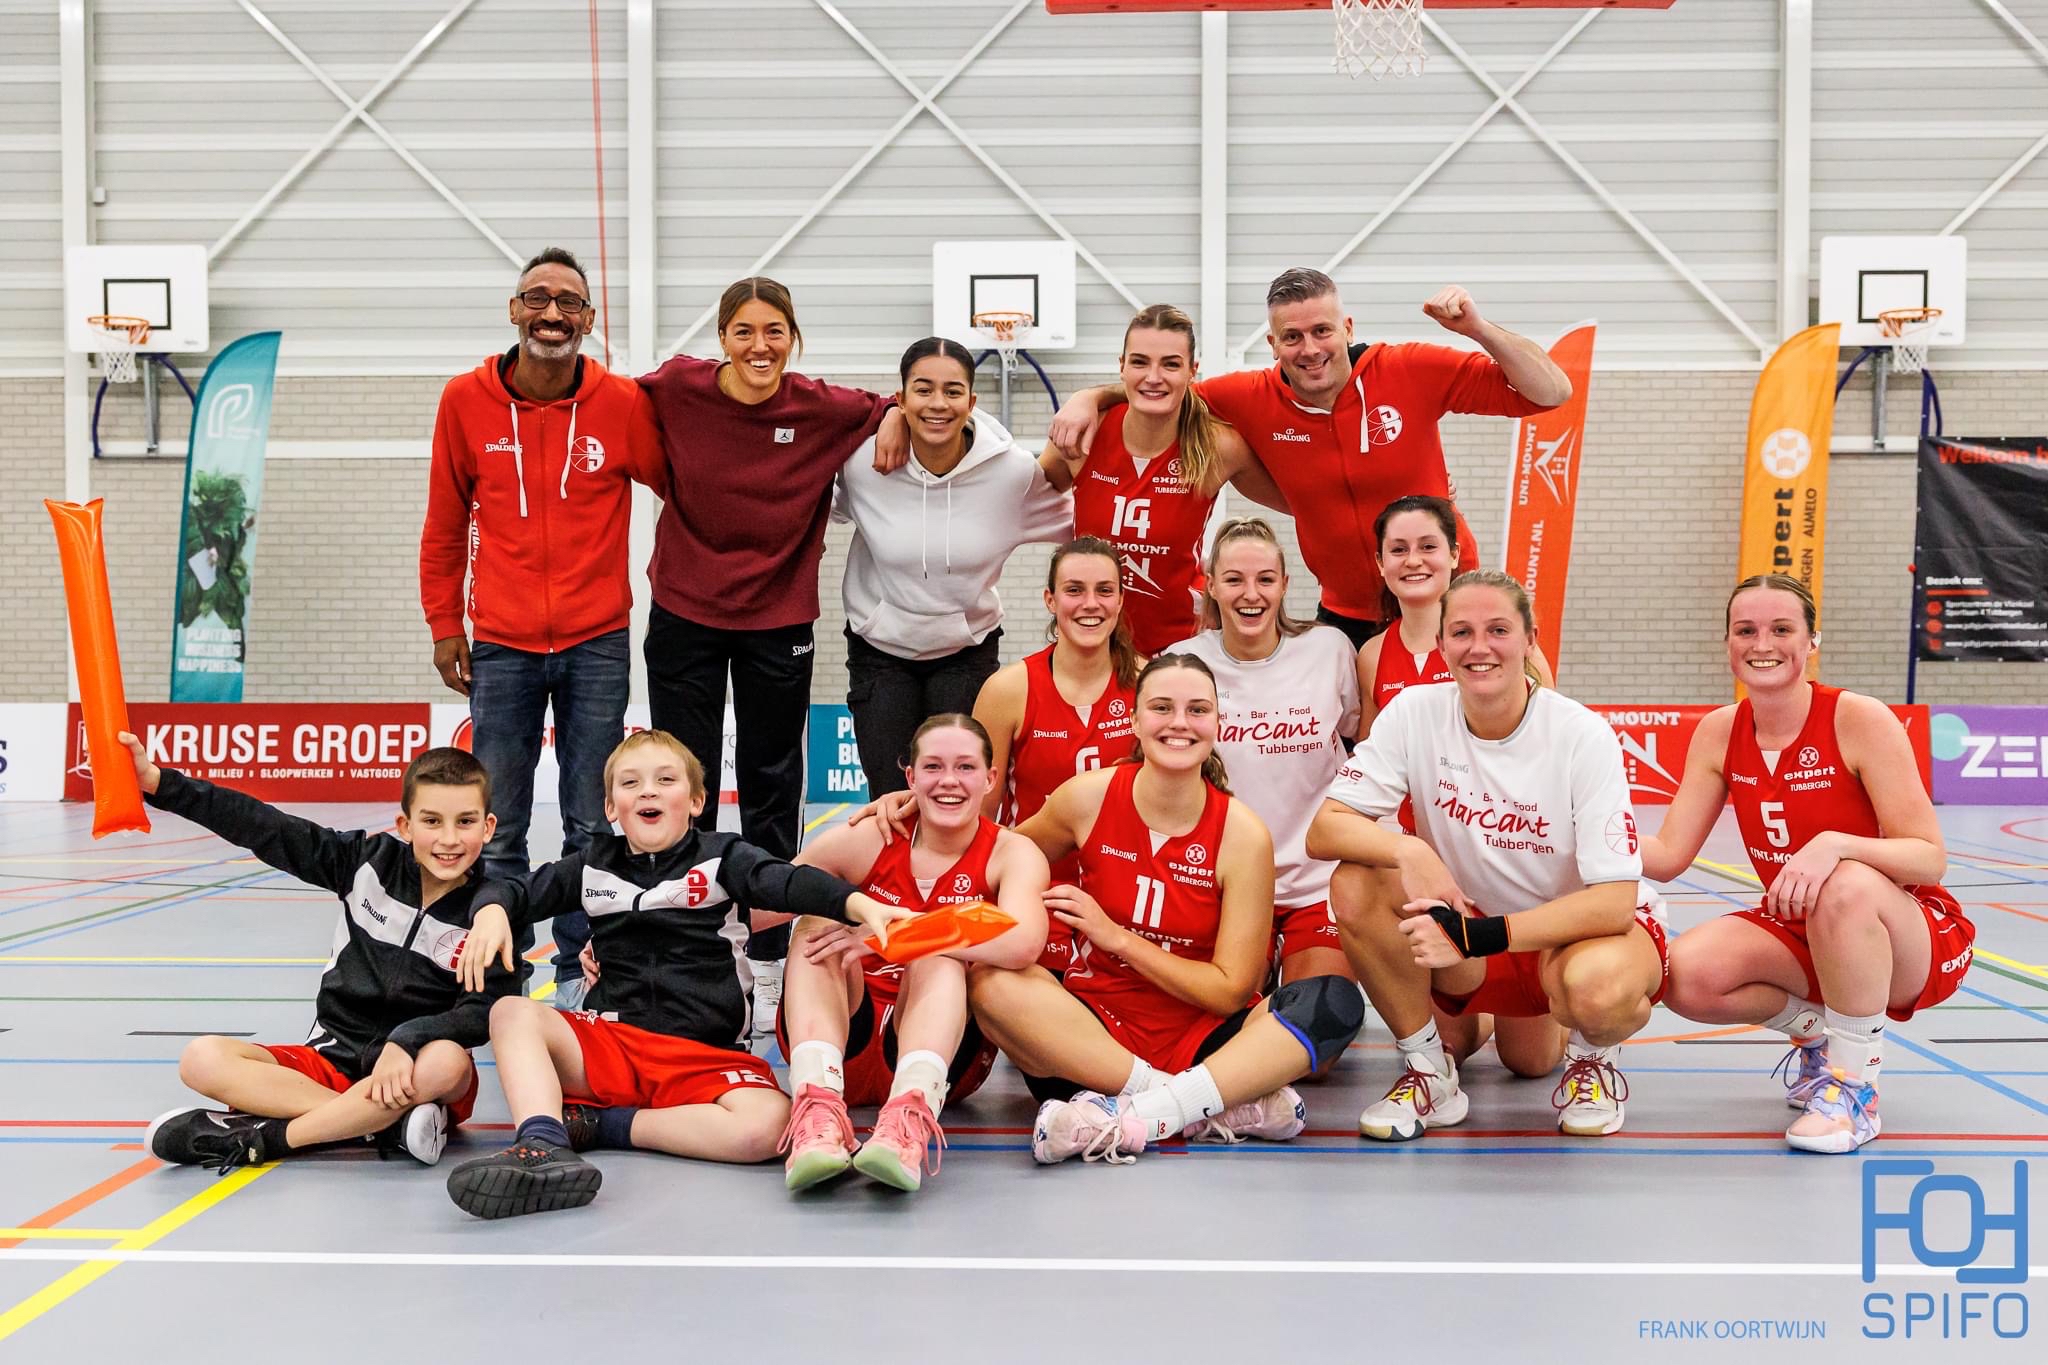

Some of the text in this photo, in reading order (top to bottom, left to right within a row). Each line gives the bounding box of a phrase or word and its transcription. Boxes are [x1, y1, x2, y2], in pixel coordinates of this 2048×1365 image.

[1273, 433, 1310, 443] SPALDING
[485, 443, 523, 453] SPALDIG
[1937, 446, 2030, 465] Welkom
[1518, 423, 1537, 506] UNI-MOUNT
[1111, 494, 1151, 539] 14
[1803, 488, 1818, 537] ALMELO
[1772, 488, 1794, 576] pert
[1110, 540, 1171, 555] -MOUNT
[1524, 519, 1545, 602] OUNT.NL
[1250, 711, 1268, 719] Bar
[1288, 706, 1311, 716] Food
[1609, 711, 1681, 726] MOUNT
[1097, 717, 1131, 730] expe
[1033, 729, 1068, 739] SPALDING
[146, 724, 428, 764] KRUSE GROEP
[1257, 742, 1323, 755] Tubbergen
[1961, 735, 2048, 778] ZE
[208, 768, 402, 778] MILIEU SLOOPWERKEN VASTGOED
[1783, 766, 1836, 781] expert
[1790, 781, 1832, 792] TUBBERGEN
[1434, 797, 1551, 838] MarCant
[1760, 801, 1791, 848] 5
[1100, 844, 1137, 862] SPALDING
[1483, 834, 1554, 854] Tubbergen
[1750, 846, 1792, 864] UNI-MO
[1168, 862, 1214, 877] exper
[1172, 874, 1213, 888] TUBBERGEN
[585, 888, 617, 900] SPALDING
[1132, 874, 1165, 929] 11
[361, 898, 388, 925] SPALDING
